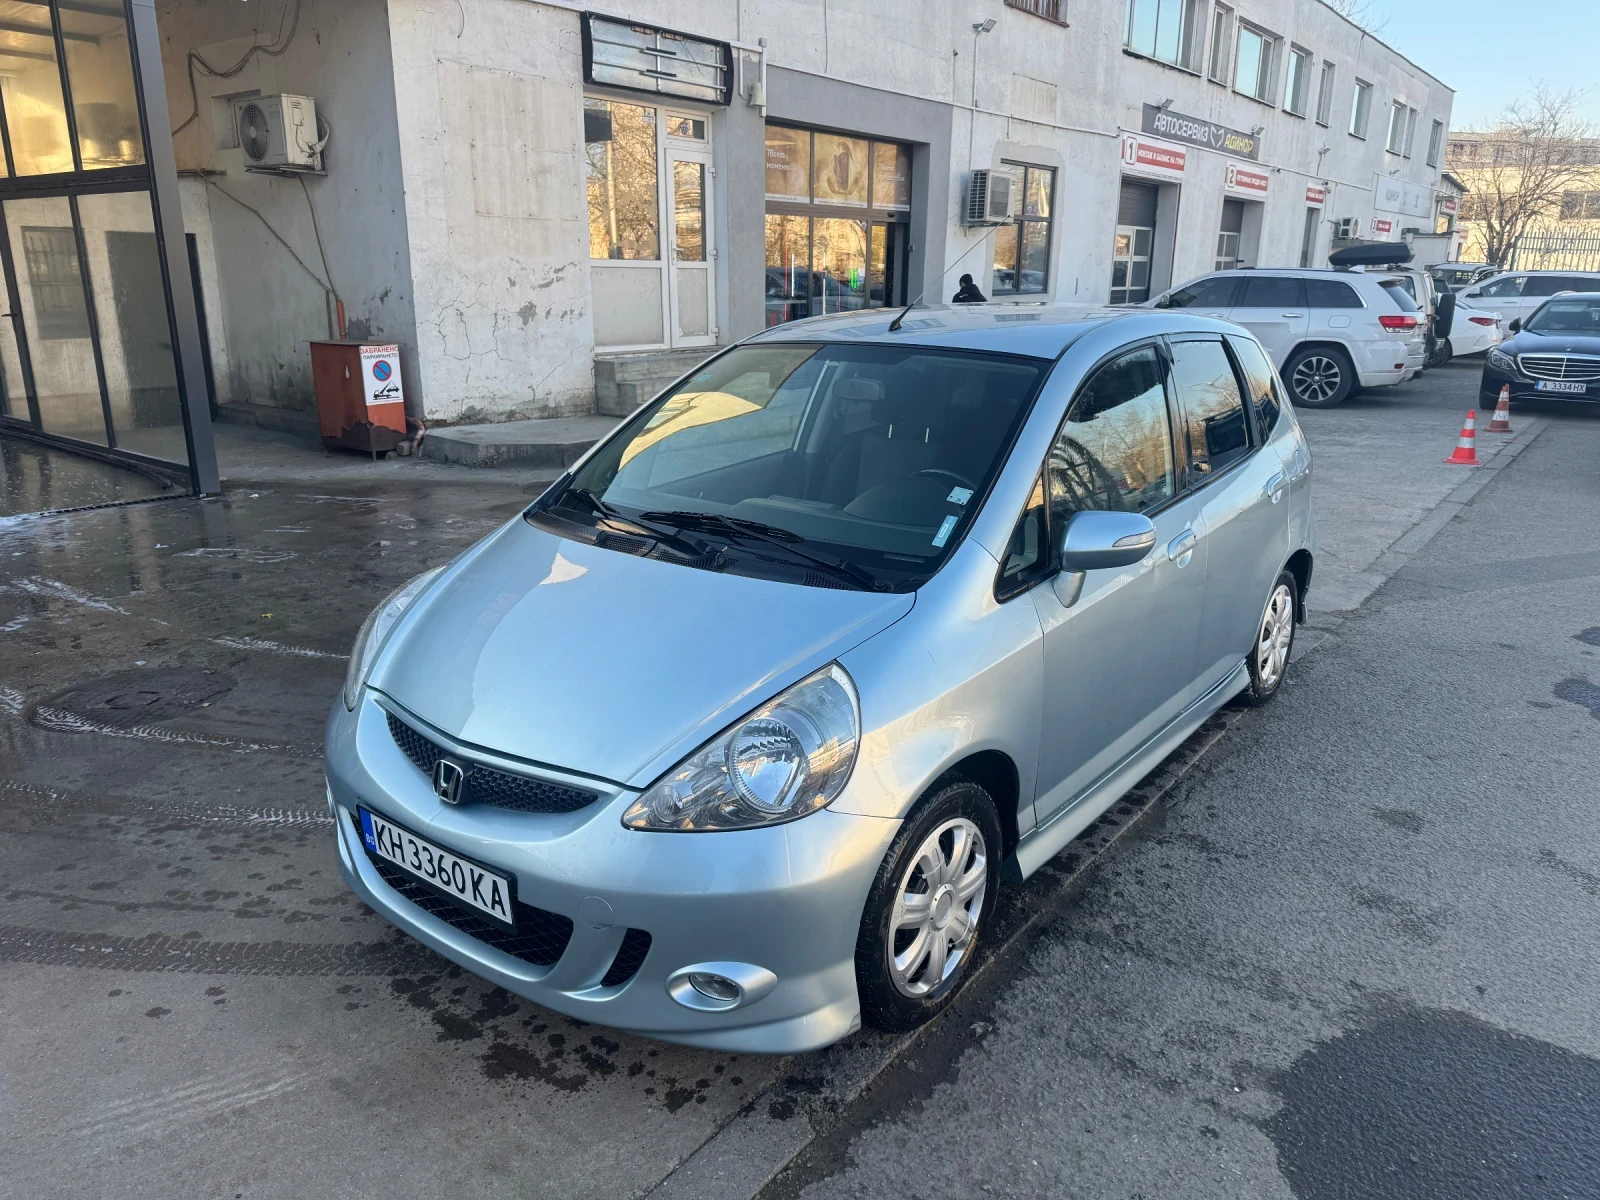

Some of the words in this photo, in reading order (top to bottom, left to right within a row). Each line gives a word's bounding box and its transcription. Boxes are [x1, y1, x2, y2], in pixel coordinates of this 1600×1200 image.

[1154, 113, 1209, 142] АВТОСЕРВИЗ
[1224, 134, 1254, 153] АДИНОР
[1229, 168, 1235, 184] 2
[366, 833, 375, 845] BG
